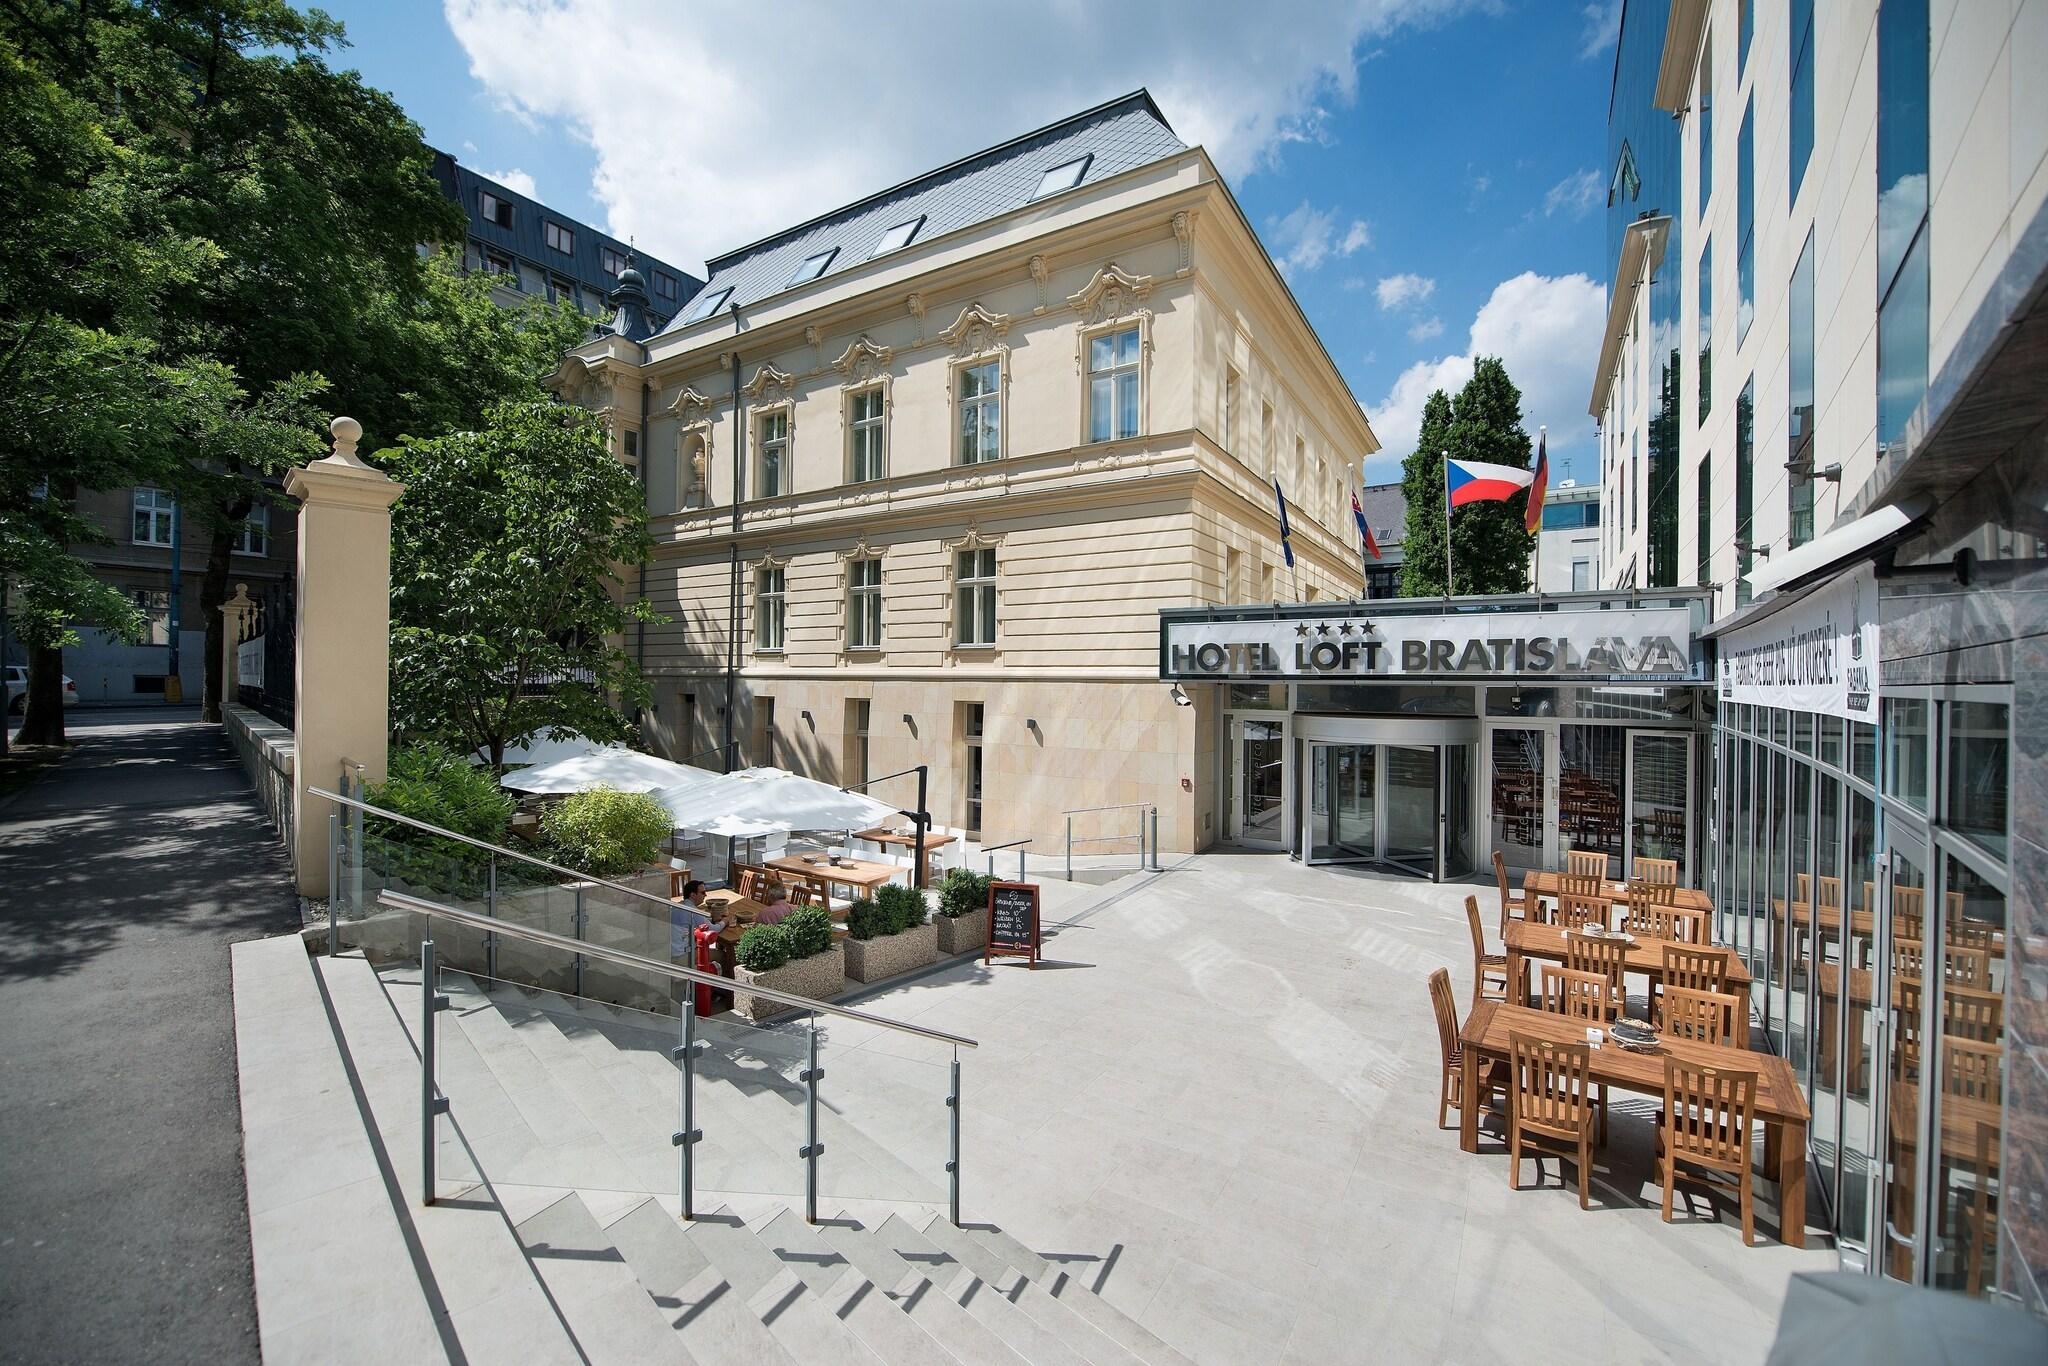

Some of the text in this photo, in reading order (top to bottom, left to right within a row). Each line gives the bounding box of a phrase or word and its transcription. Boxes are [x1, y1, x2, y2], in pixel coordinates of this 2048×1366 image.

[1172, 636, 1688, 673] HOTEL LOFT BRATISLAVA
[1797, 610, 1833, 687] OTVORENÉ
